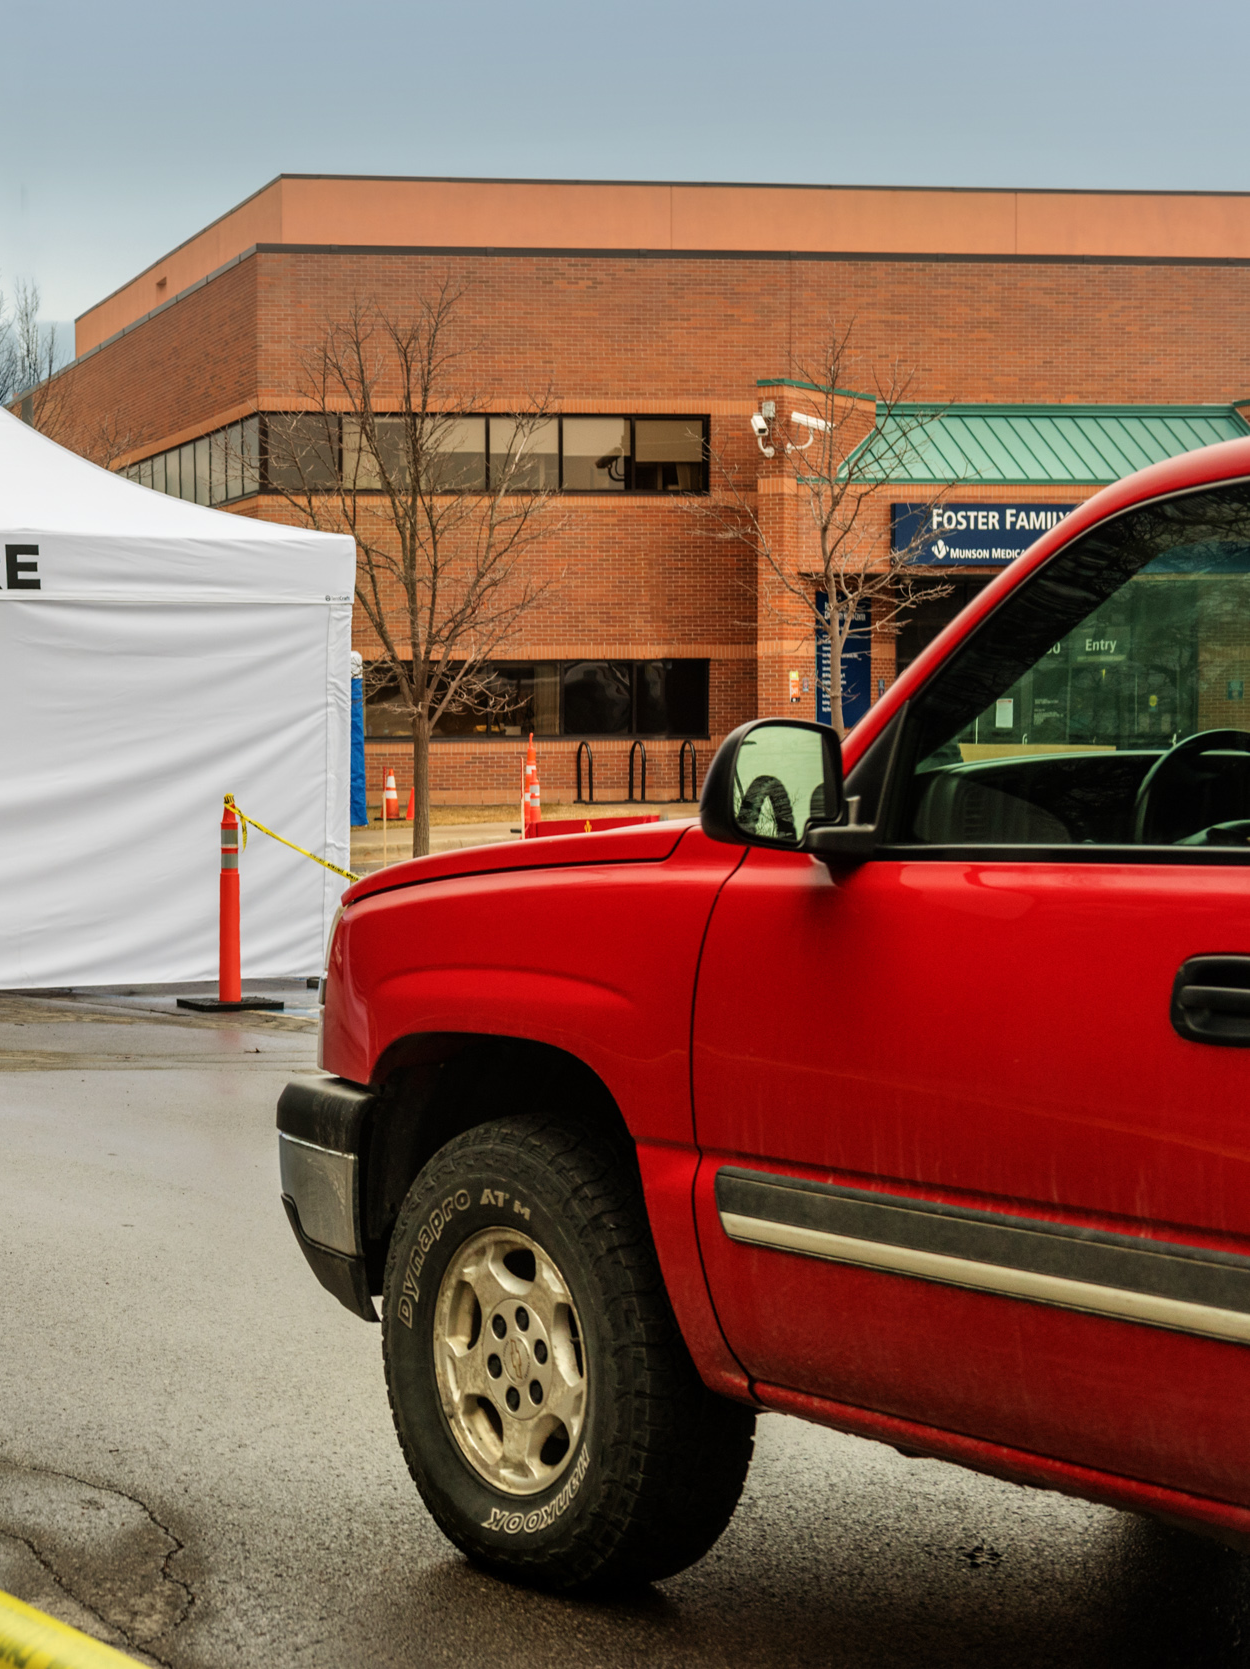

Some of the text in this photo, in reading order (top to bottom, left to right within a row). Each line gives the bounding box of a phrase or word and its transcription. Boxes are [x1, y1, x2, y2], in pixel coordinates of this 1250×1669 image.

[932, 508, 999, 530] FOSTER
[950, 547, 989, 560] MUNSON
[1085, 638, 1117, 653] Entry
